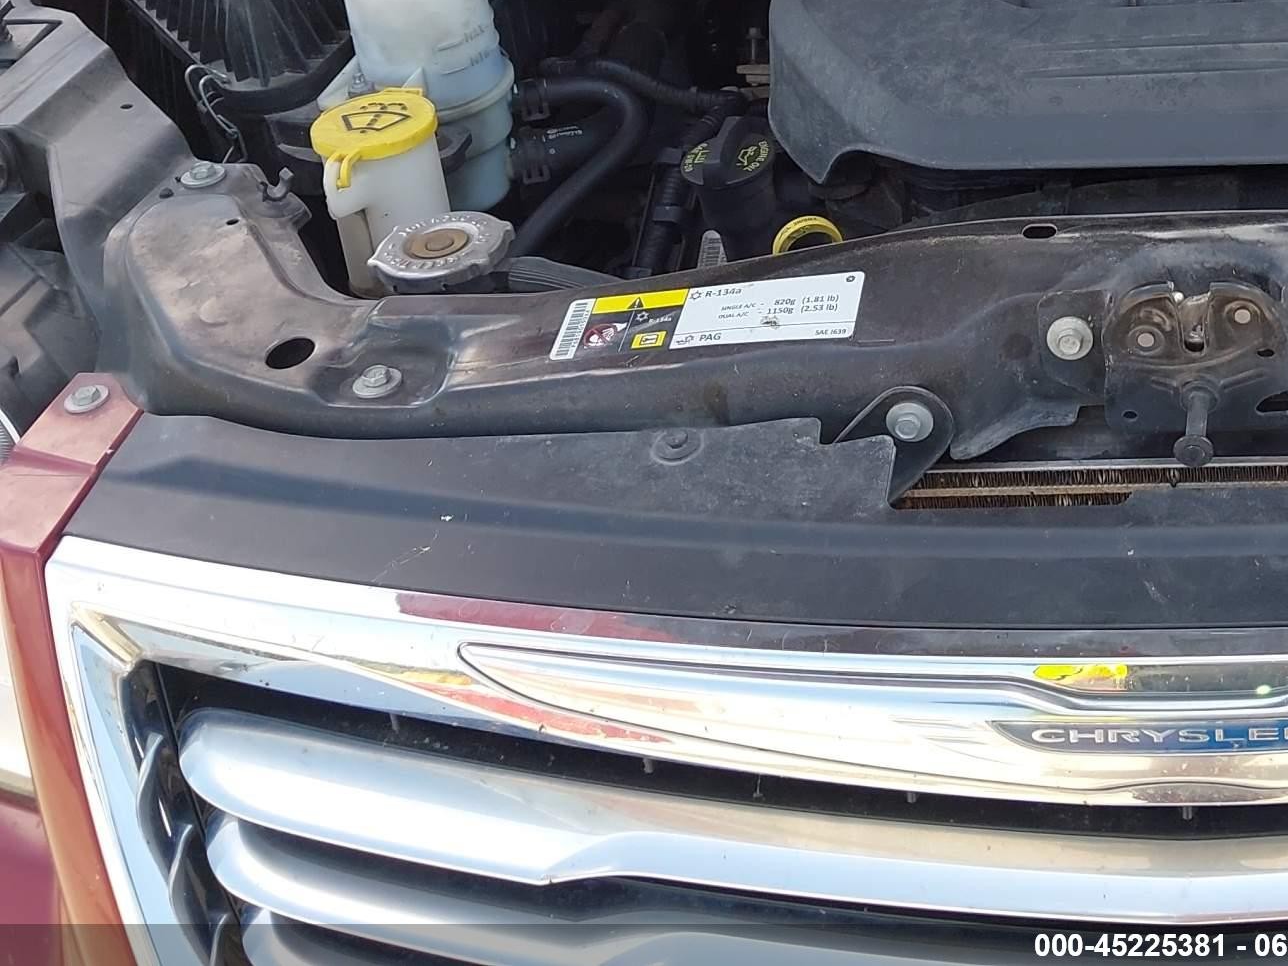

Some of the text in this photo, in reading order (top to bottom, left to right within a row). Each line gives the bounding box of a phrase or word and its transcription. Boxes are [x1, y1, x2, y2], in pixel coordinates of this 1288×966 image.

[704, 287, 742, 298] R-134a
[773, 298, 797, 307] 820g
[801, 295, 825, 305] (1.81
[826, 294, 840, 305] lb)
[766, 307, 794, 316] 1150g
[800, 304, 825, 314] (2.53
[825, 303, 839, 313] lb)
[698, 332, 722, 342] PAG
